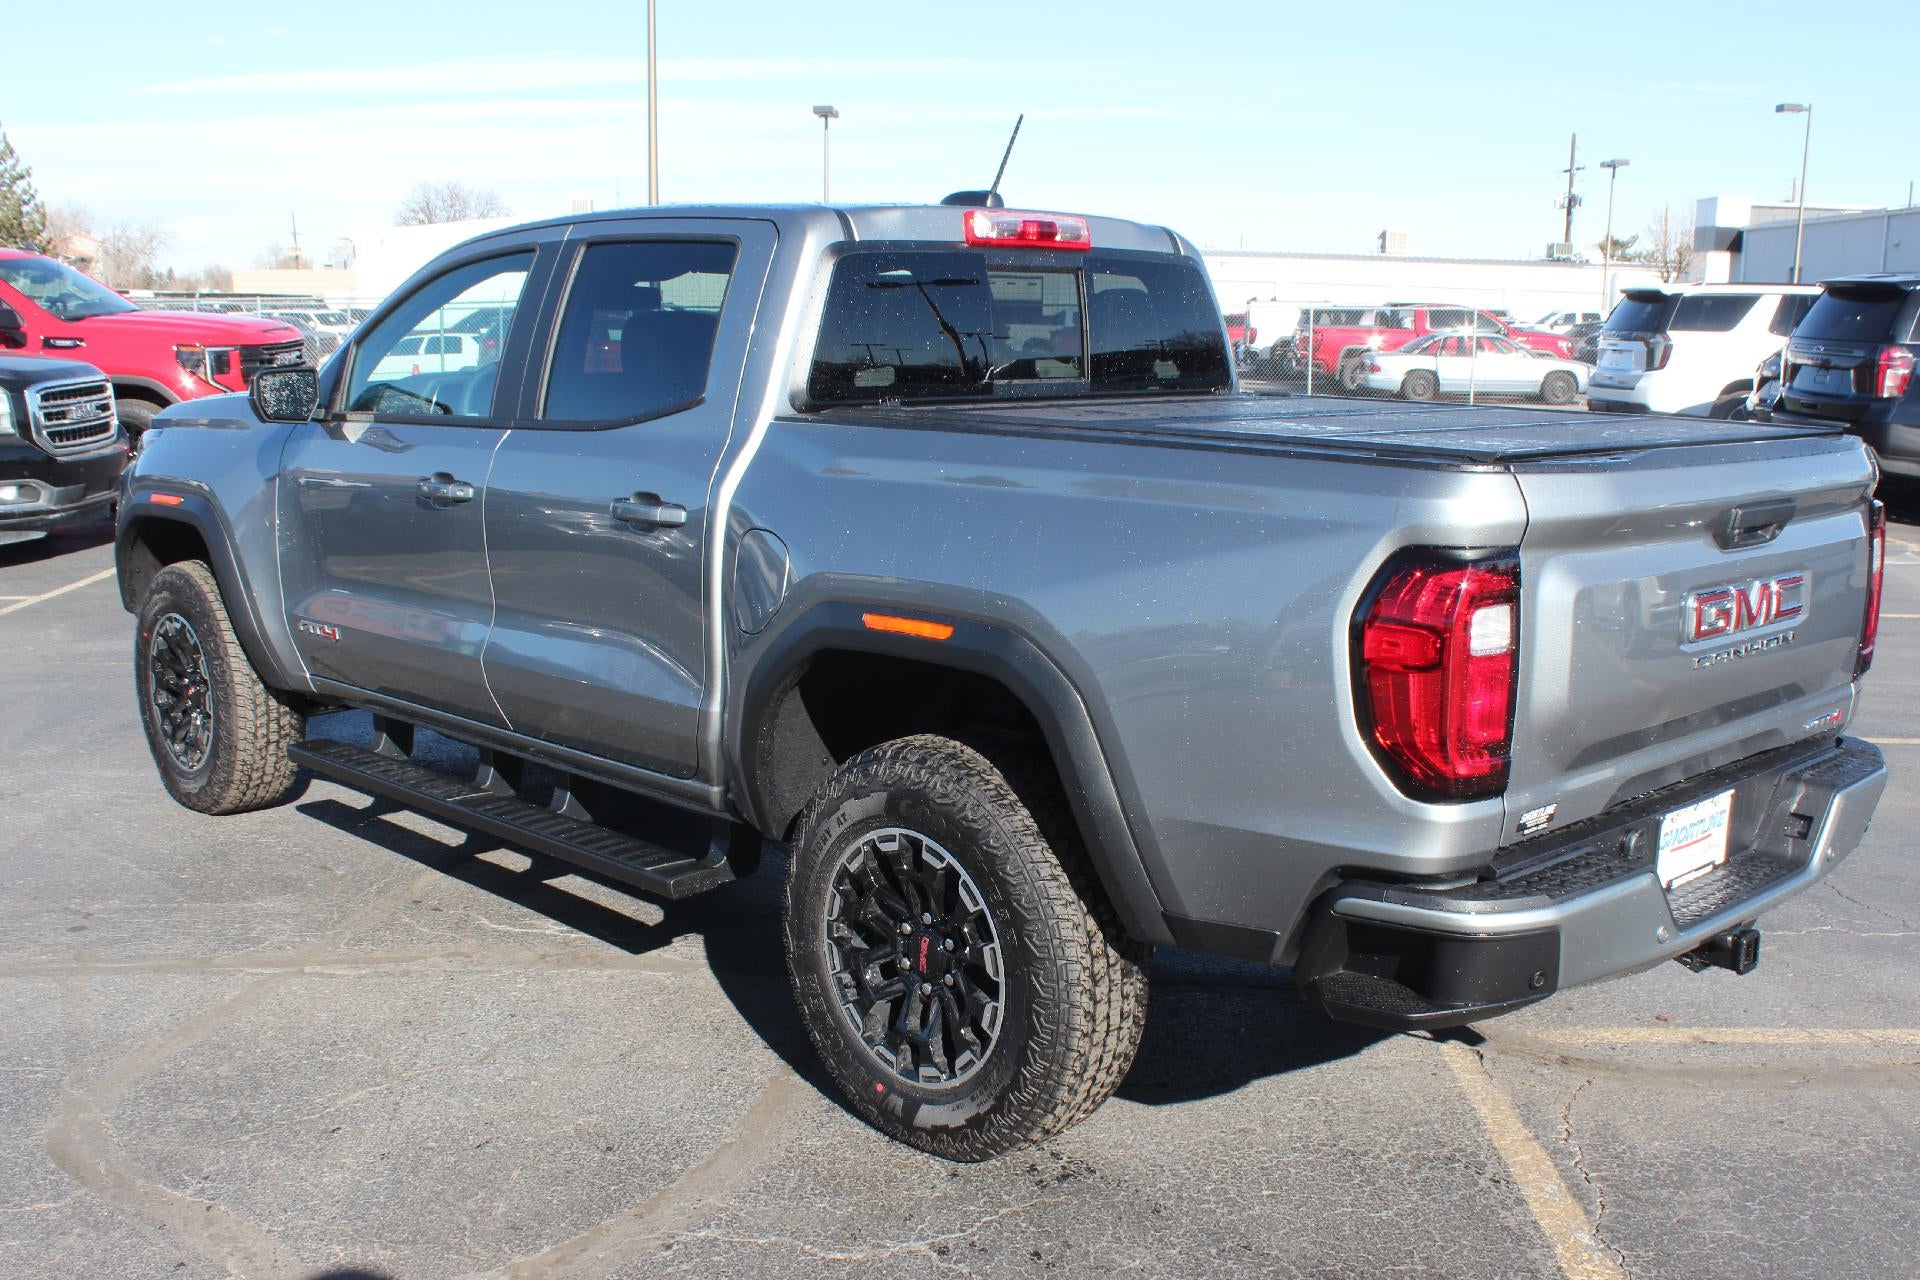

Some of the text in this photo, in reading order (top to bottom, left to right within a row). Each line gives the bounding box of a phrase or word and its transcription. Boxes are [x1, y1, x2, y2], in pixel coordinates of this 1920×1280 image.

[1690, 574, 1804, 642] GMC
[299, 620, 340, 641] AT4
[1692, 631, 1796, 670] CANYON
[1658, 809, 1727, 851] SHORTLINE
[919, 936, 930, 975] GMC
